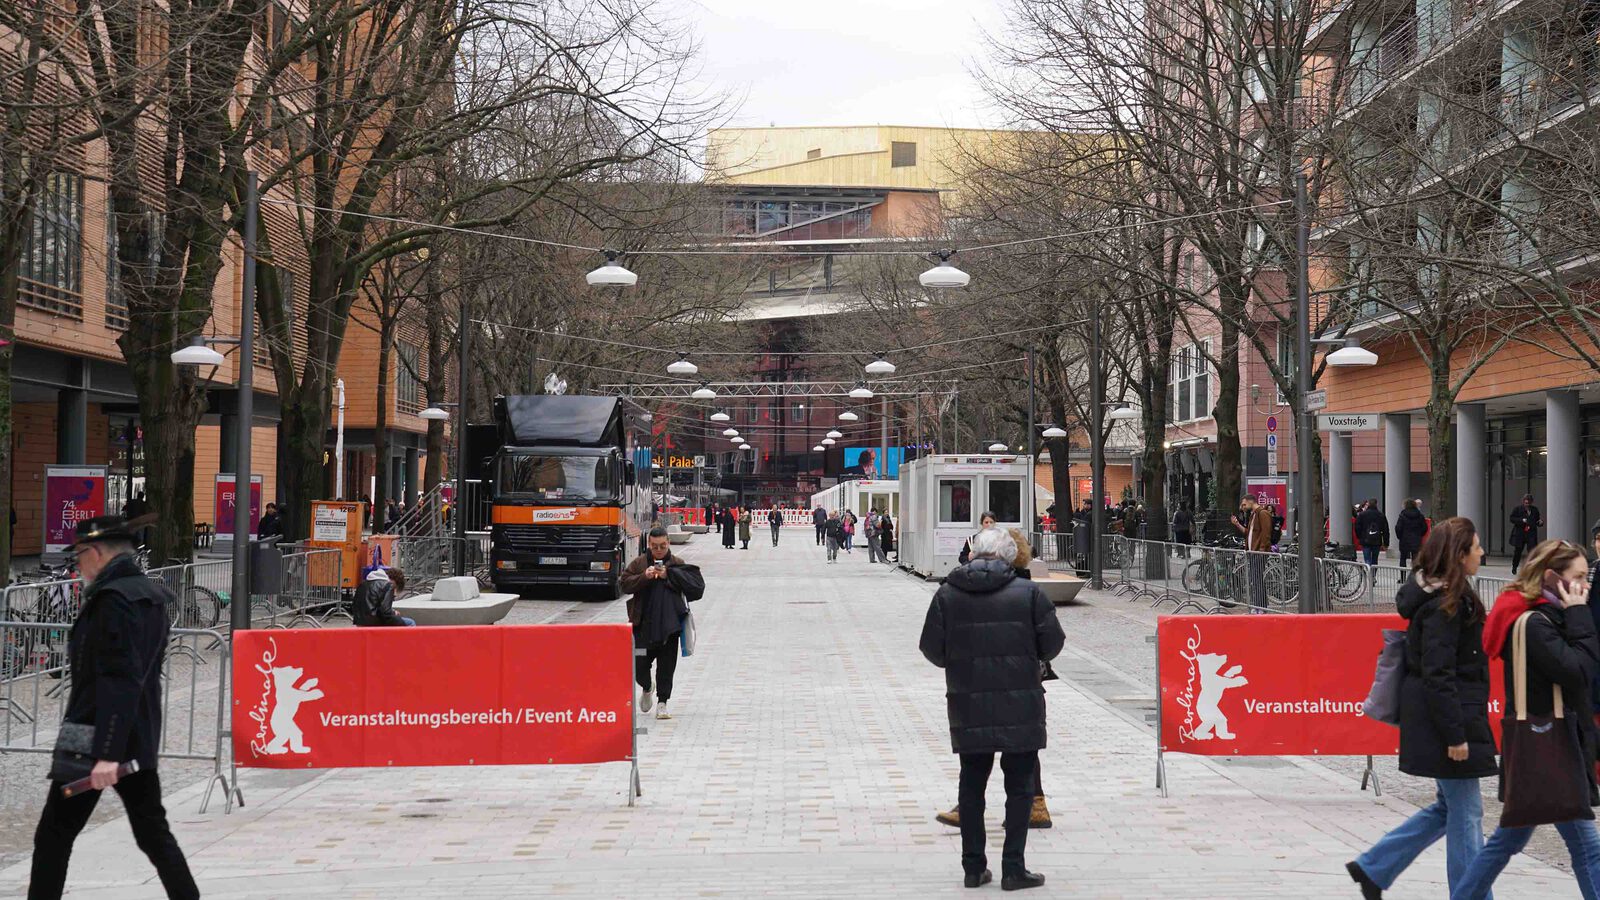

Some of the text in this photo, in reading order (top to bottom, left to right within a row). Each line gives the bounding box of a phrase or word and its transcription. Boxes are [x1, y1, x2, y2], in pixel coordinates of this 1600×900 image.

[1328, 416, 1368, 427] Voxstraße
[249, 636, 277, 758] Berlinale
[577, 707, 617, 723] Area
[1176, 623, 1201, 744] Berlinale
